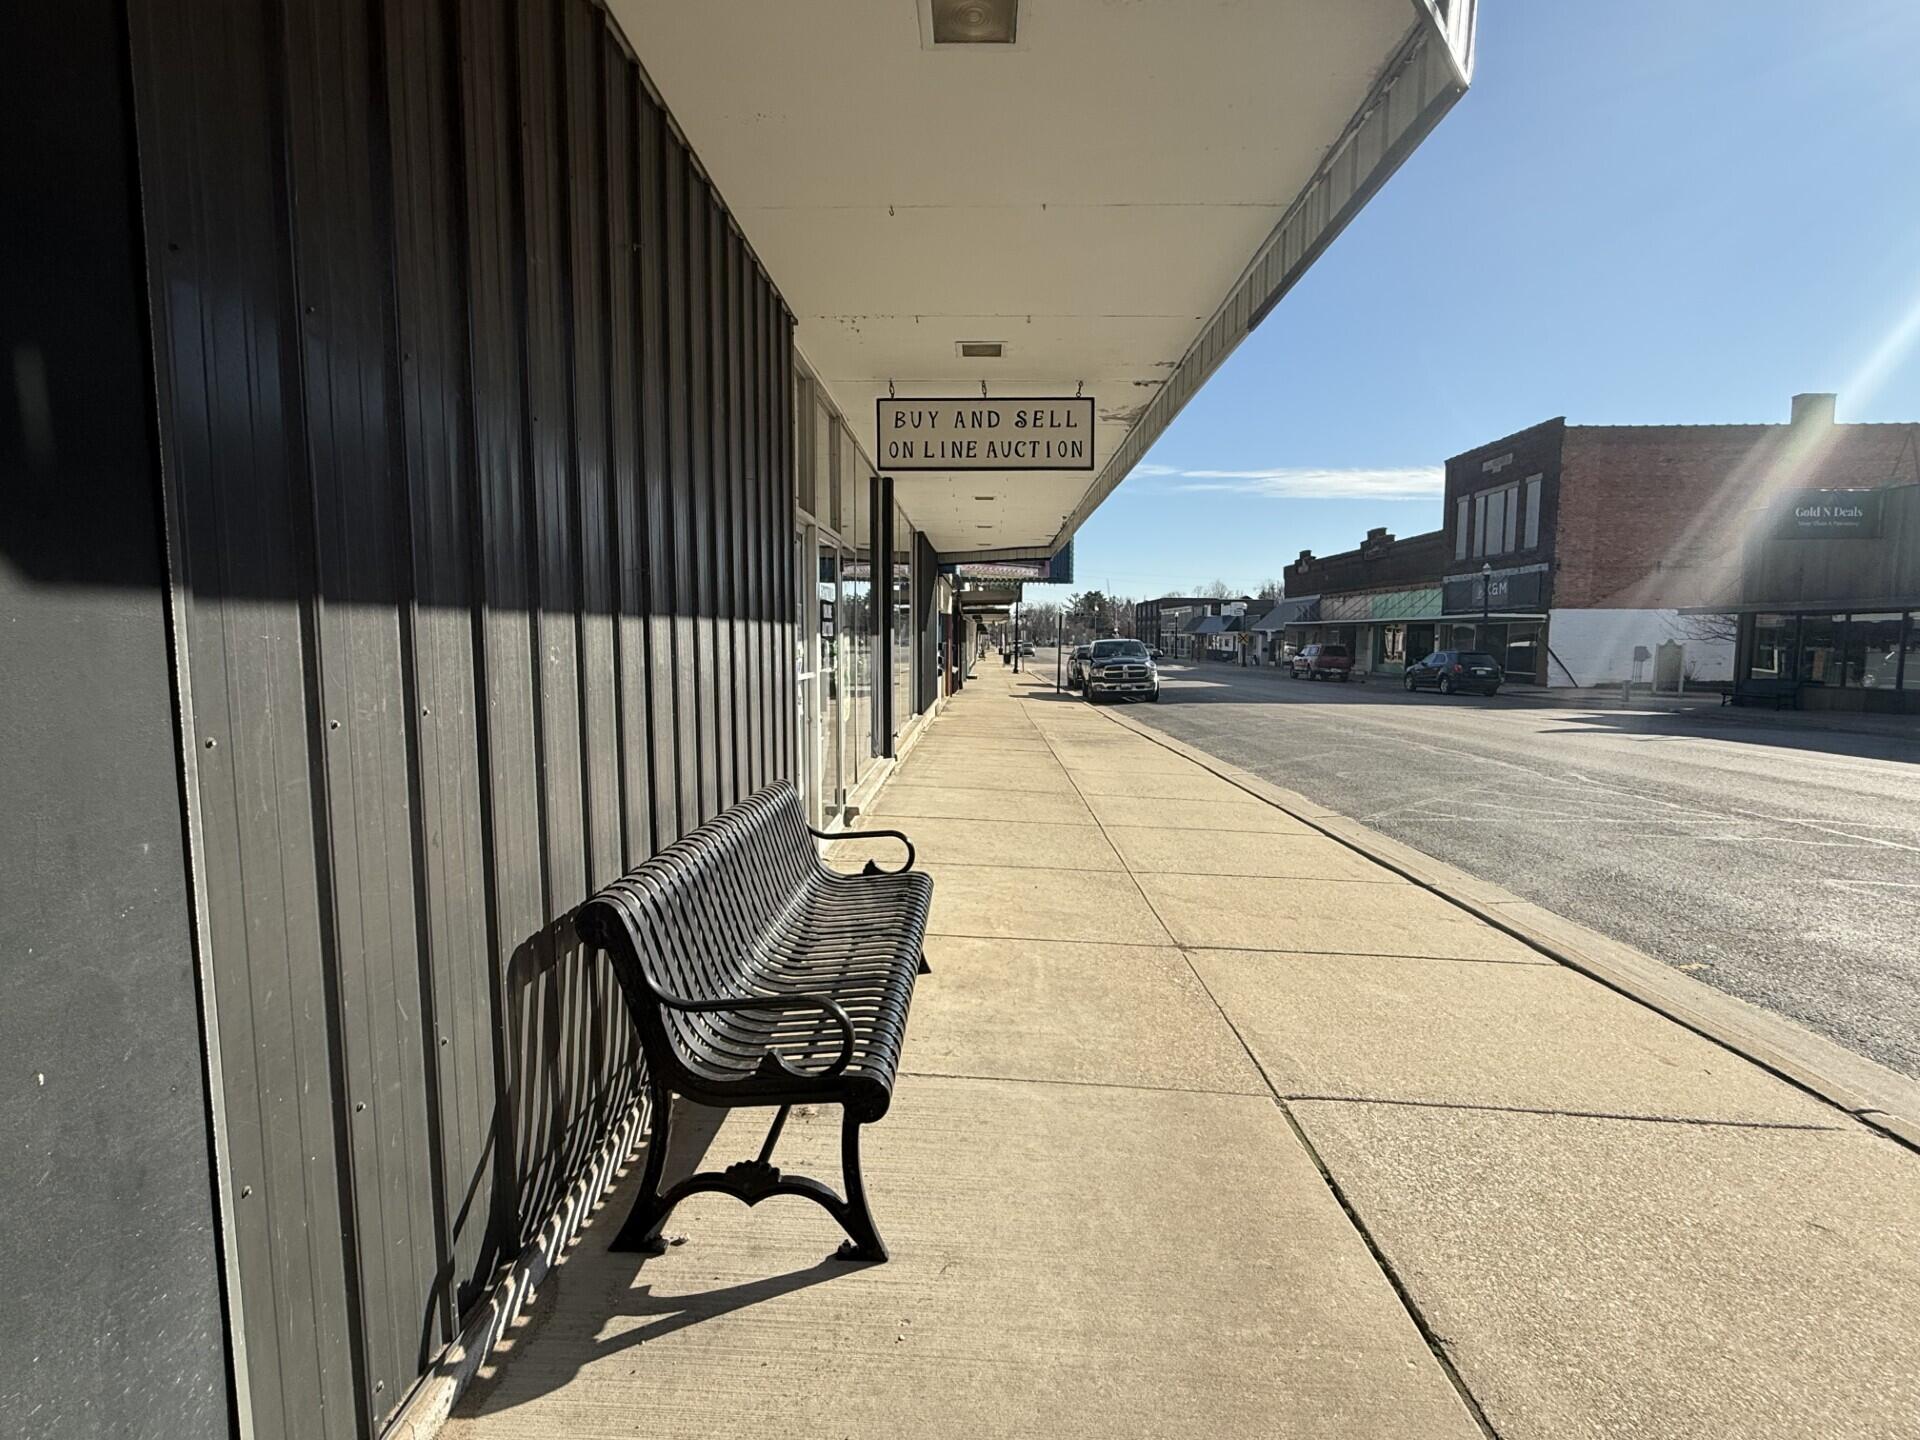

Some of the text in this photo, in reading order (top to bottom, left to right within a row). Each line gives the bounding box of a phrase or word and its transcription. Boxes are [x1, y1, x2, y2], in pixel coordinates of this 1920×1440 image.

[894, 409, 1078, 429] BUY AND SELL
[986, 440, 1083, 458] AUCTION
[1795, 506, 1863, 517] Gold N Deals
